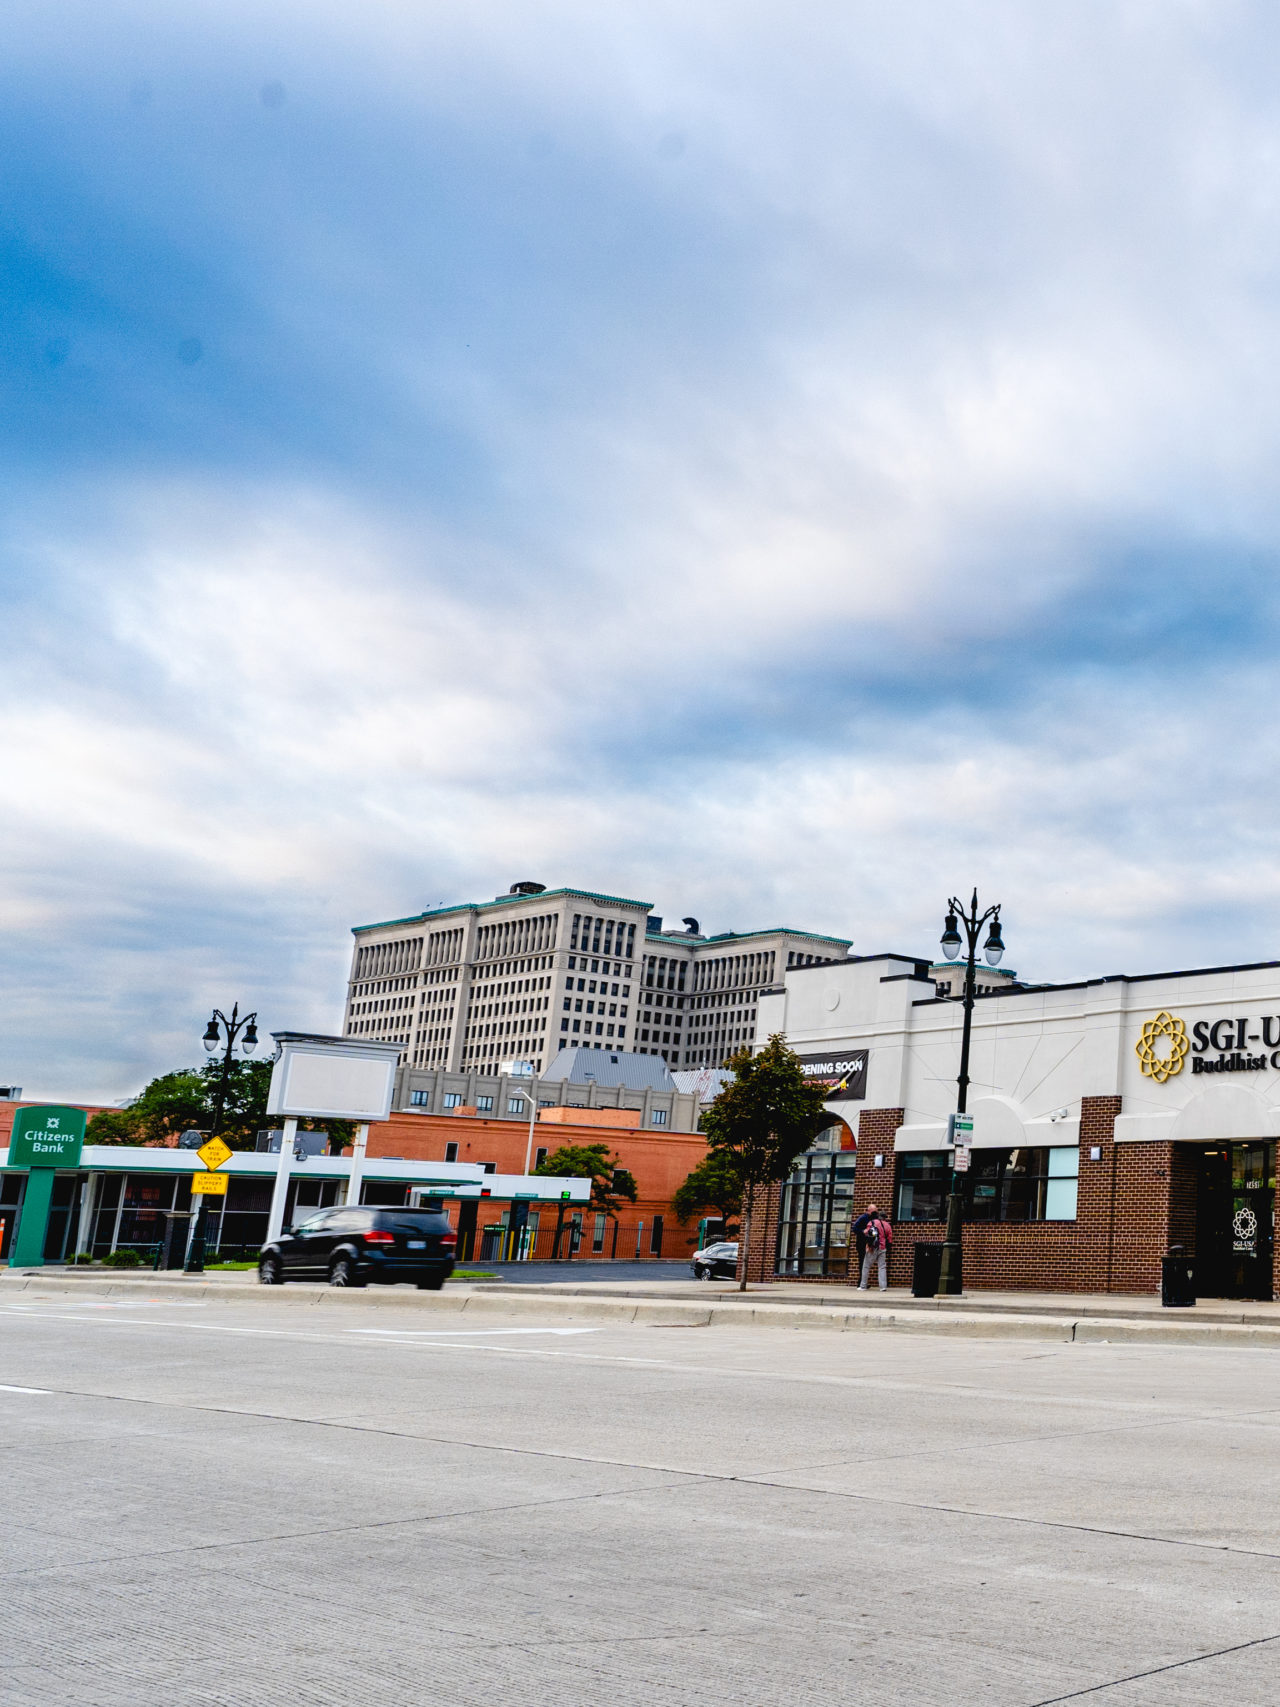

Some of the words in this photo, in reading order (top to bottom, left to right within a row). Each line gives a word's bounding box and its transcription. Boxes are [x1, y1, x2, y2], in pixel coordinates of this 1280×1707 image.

[795, 1062, 834, 1076] PENING
[835, 1059, 863, 1073] SOON
[1191, 1052, 1267, 1074] Buddhist
[24, 1130, 75, 1142] Citizens
[32, 1142, 65, 1153] Bank
